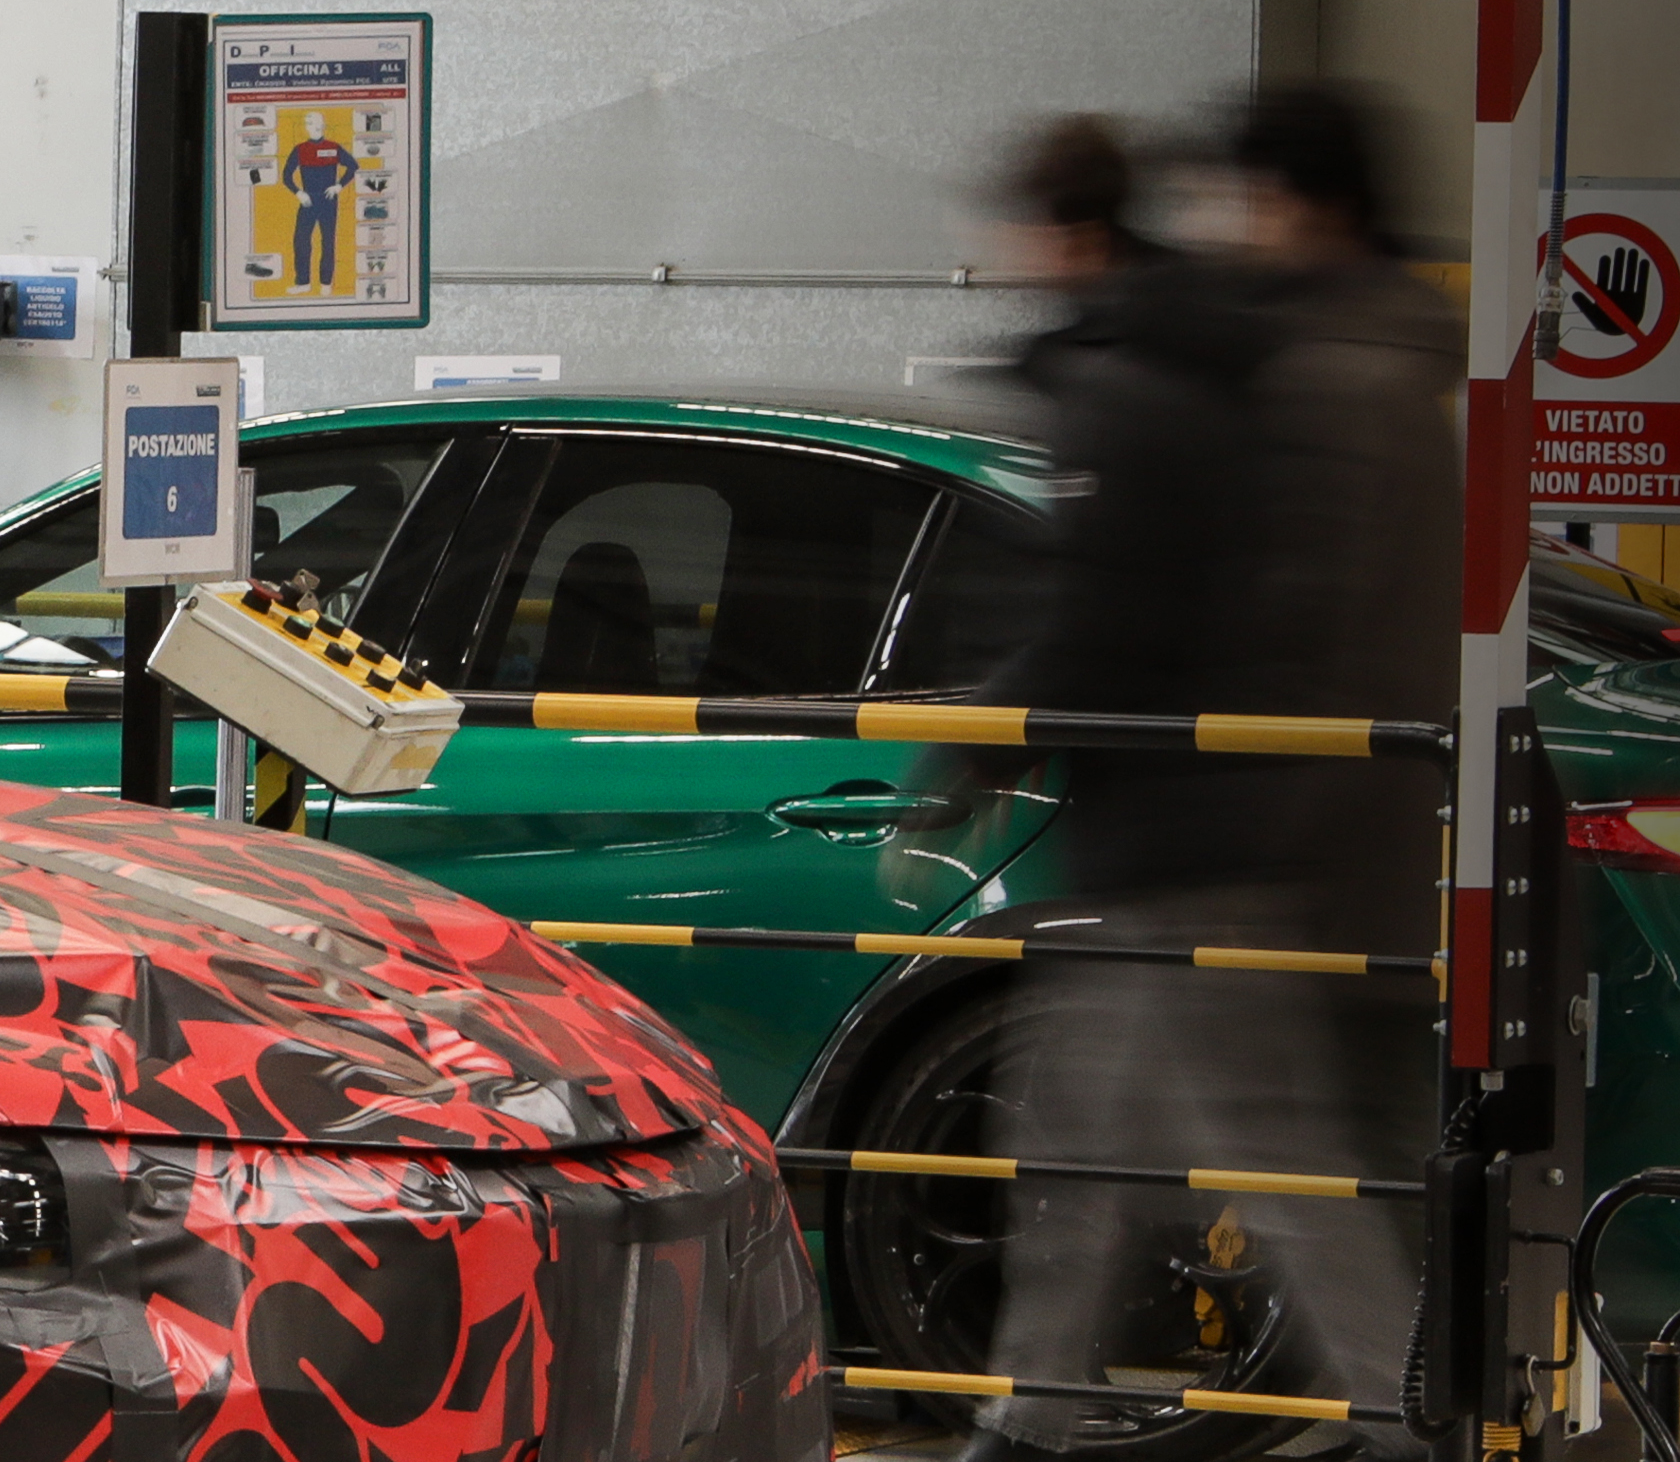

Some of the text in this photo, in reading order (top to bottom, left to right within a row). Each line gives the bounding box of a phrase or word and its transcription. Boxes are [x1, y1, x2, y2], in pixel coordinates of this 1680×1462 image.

[230, 45, 242, 58] D
[259, 44, 270, 57] P
[258, 63, 344, 77] OFFICINA 3
[380, 63, 401, 73] ALL
[1545, 409, 1645, 435] VIETATO
[128, 433, 216, 458] POSTAZIONE
[1531, 440, 1666, 466] 'INGRESSO
[1530, 471, 1581, 495] NON
[166, 485, 178, 513] 6
